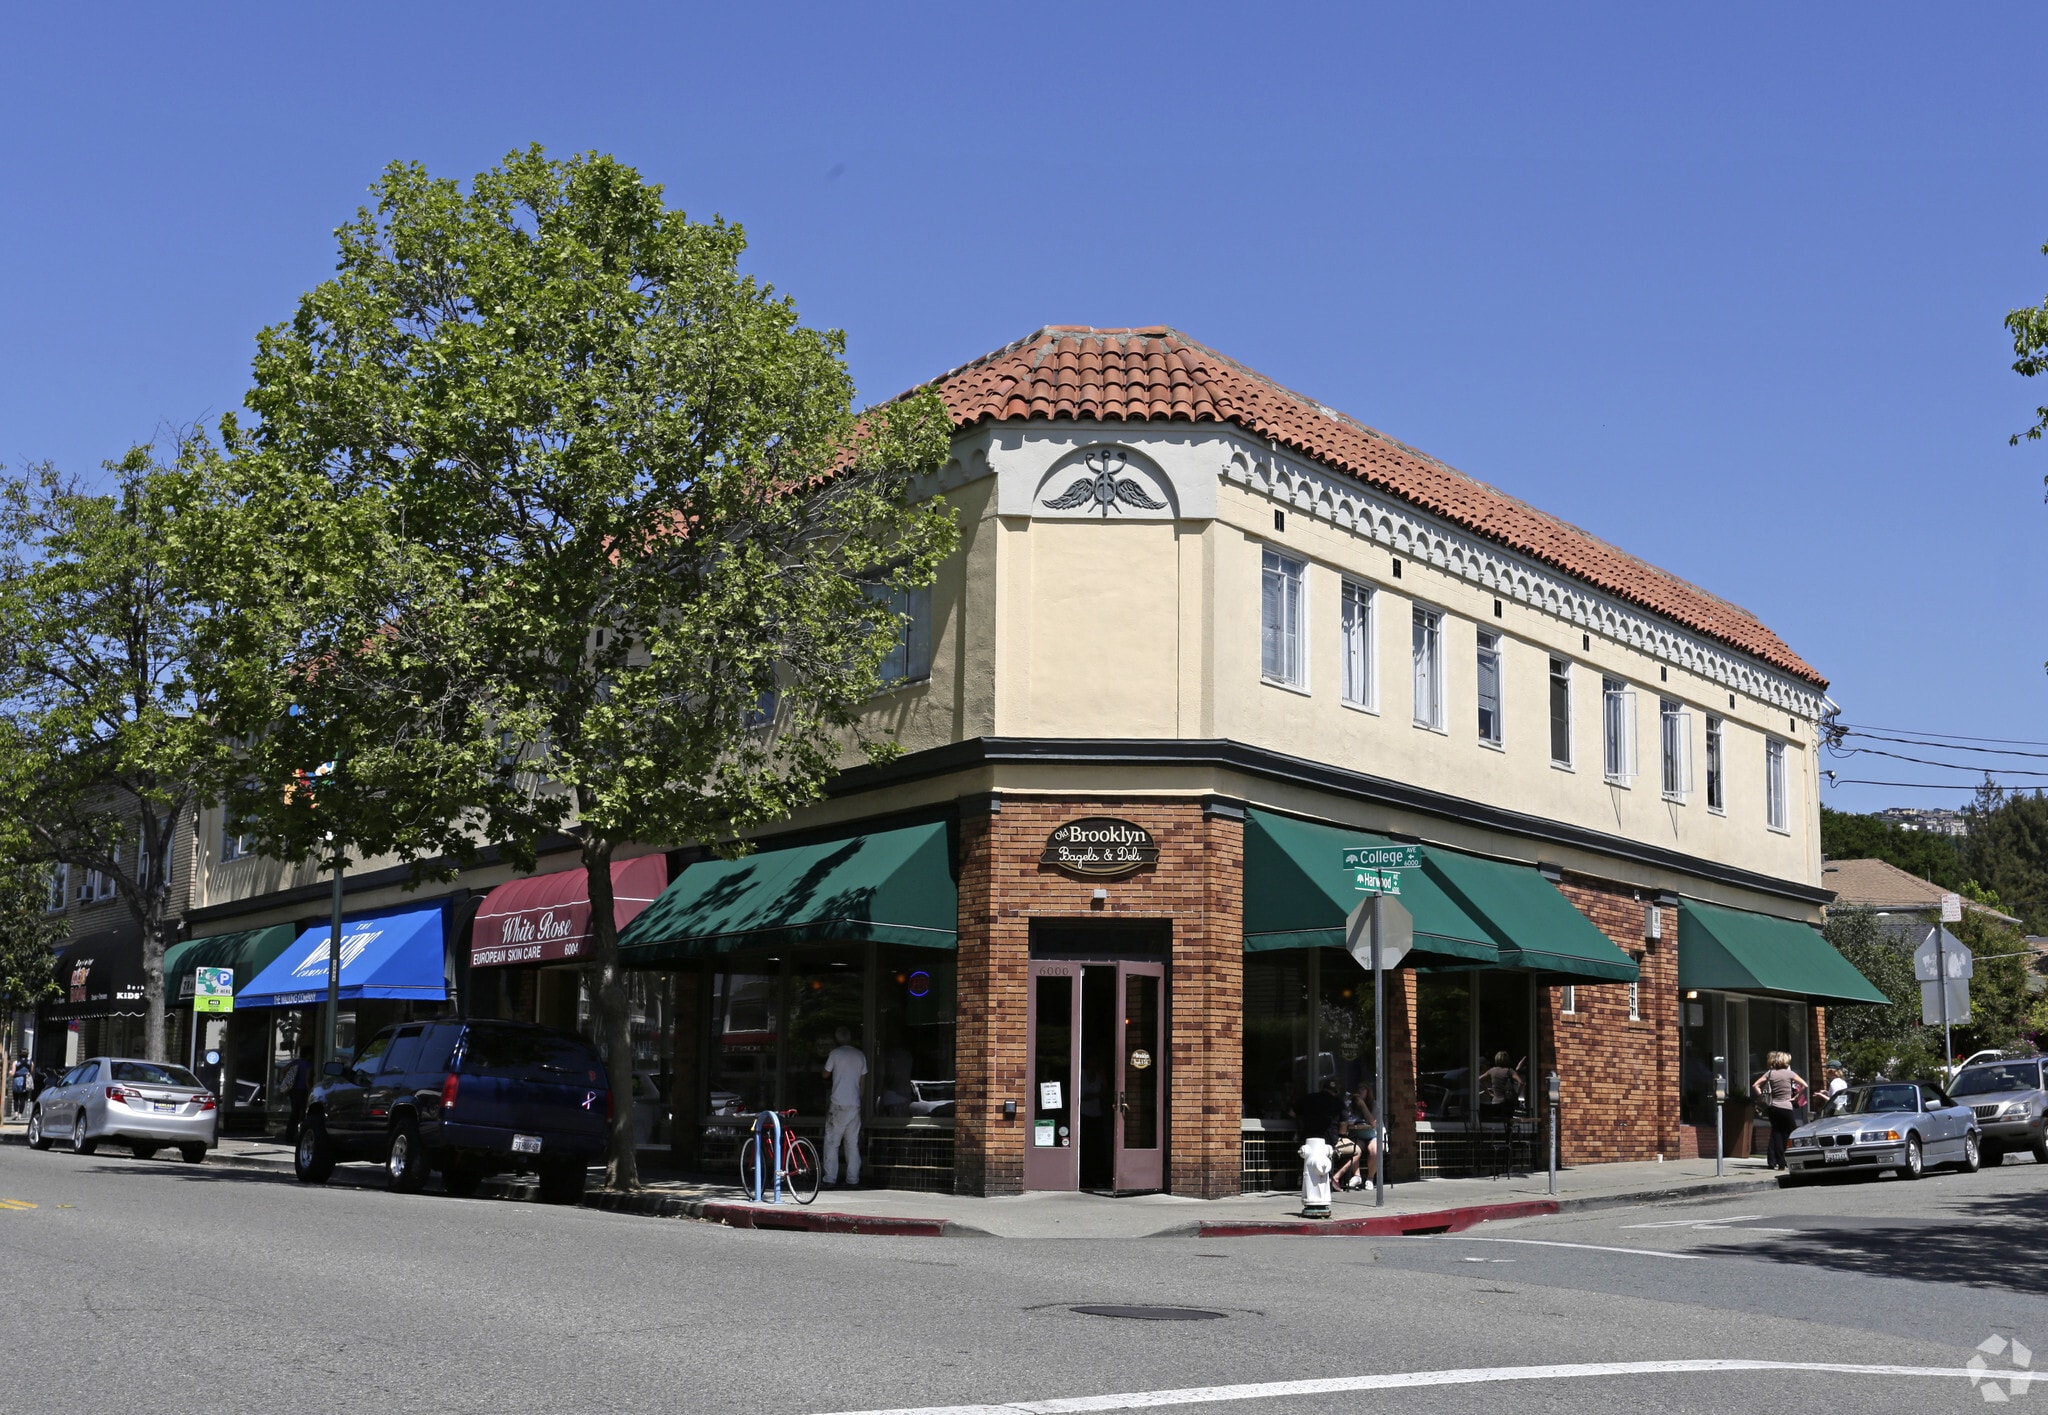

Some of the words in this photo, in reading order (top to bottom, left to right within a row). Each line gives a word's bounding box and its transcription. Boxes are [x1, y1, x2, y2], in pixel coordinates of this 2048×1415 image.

[1055, 828, 1069, 841] Old
[1069, 826, 1146, 846] Brooklyn
[1058, 846, 1099, 869] Bagels
[1103, 848, 1113, 861] &
[1117, 846, 1142, 861] Deli
[1360, 850, 1403, 866] College
[1364, 873, 1391, 889] Harwood
[502, 915, 536, 944] White
[537, 910, 572, 940] Rose
[473, 950, 506, 965] EUROPEAN
[507, 947, 522, 962] SKIN
[523, 945, 542, 959] CARE
[564, 943, 579, 955] 6004
[296, 967, 330, 978] COMPAN
[1039, 966, 1069, 976] 6000
[297, 992, 317, 1003] COMPANY
